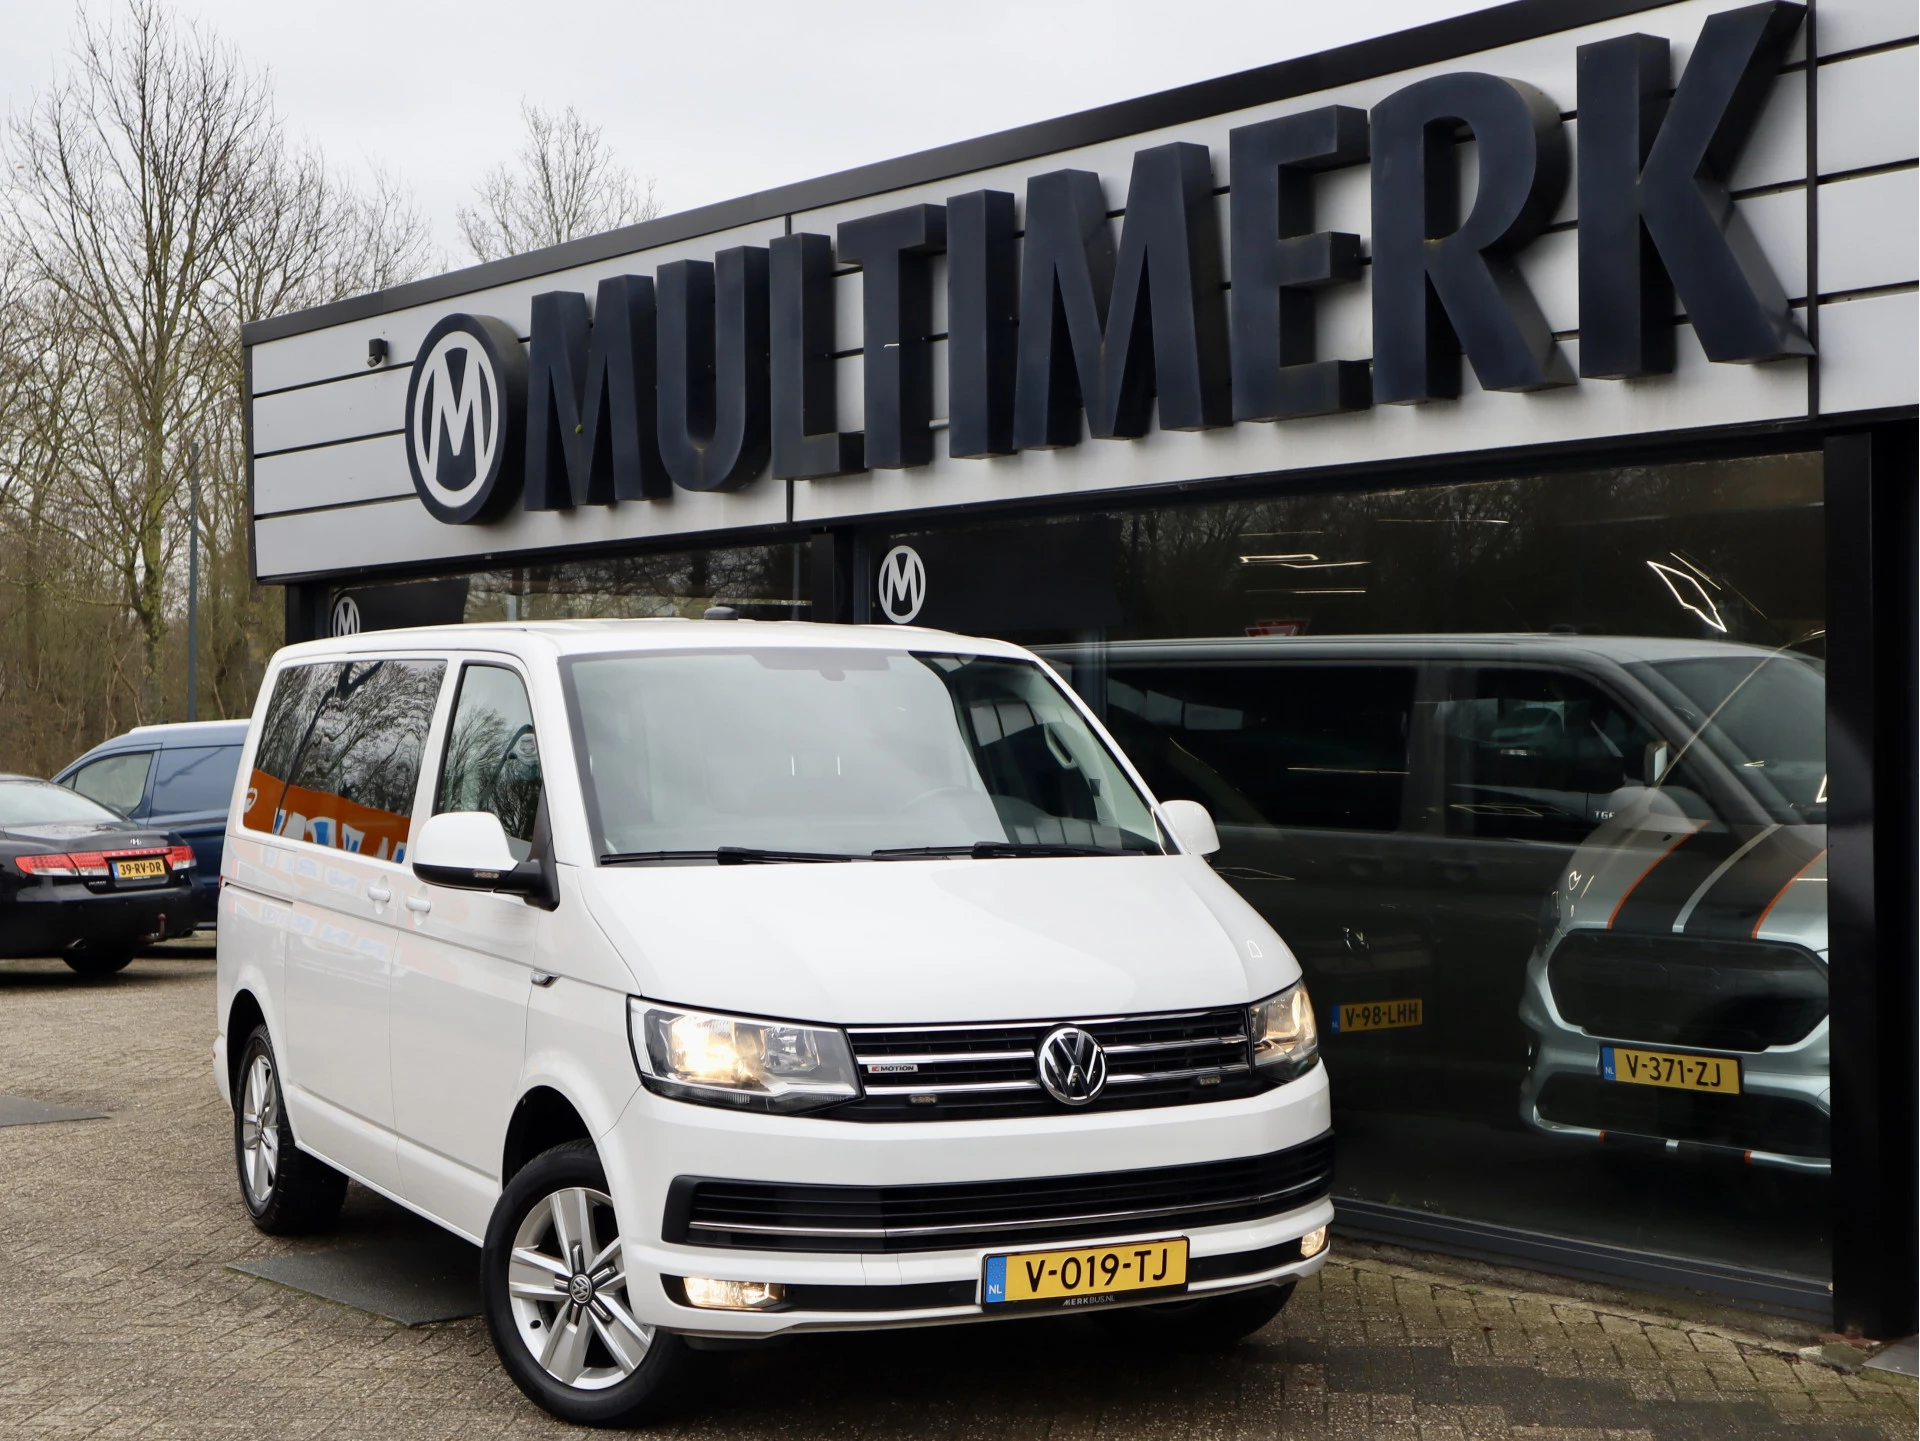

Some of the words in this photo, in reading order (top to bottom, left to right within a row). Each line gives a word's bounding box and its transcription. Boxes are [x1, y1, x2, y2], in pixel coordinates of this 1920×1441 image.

[525, 0, 1813, 511] MULTIMERK
[120, 861, 162, 876] 39-RV-DR
[1345, 1002, 1418, 1028] V-98-LHH
[1605, 1066, 1614, 1075] NL
[1625, 1053, 1722, 1087] V-371-ZJ
[988, 1283, 1003, 1295] NL
[1025, 1248, 1168, 1293] V-019-TJ
